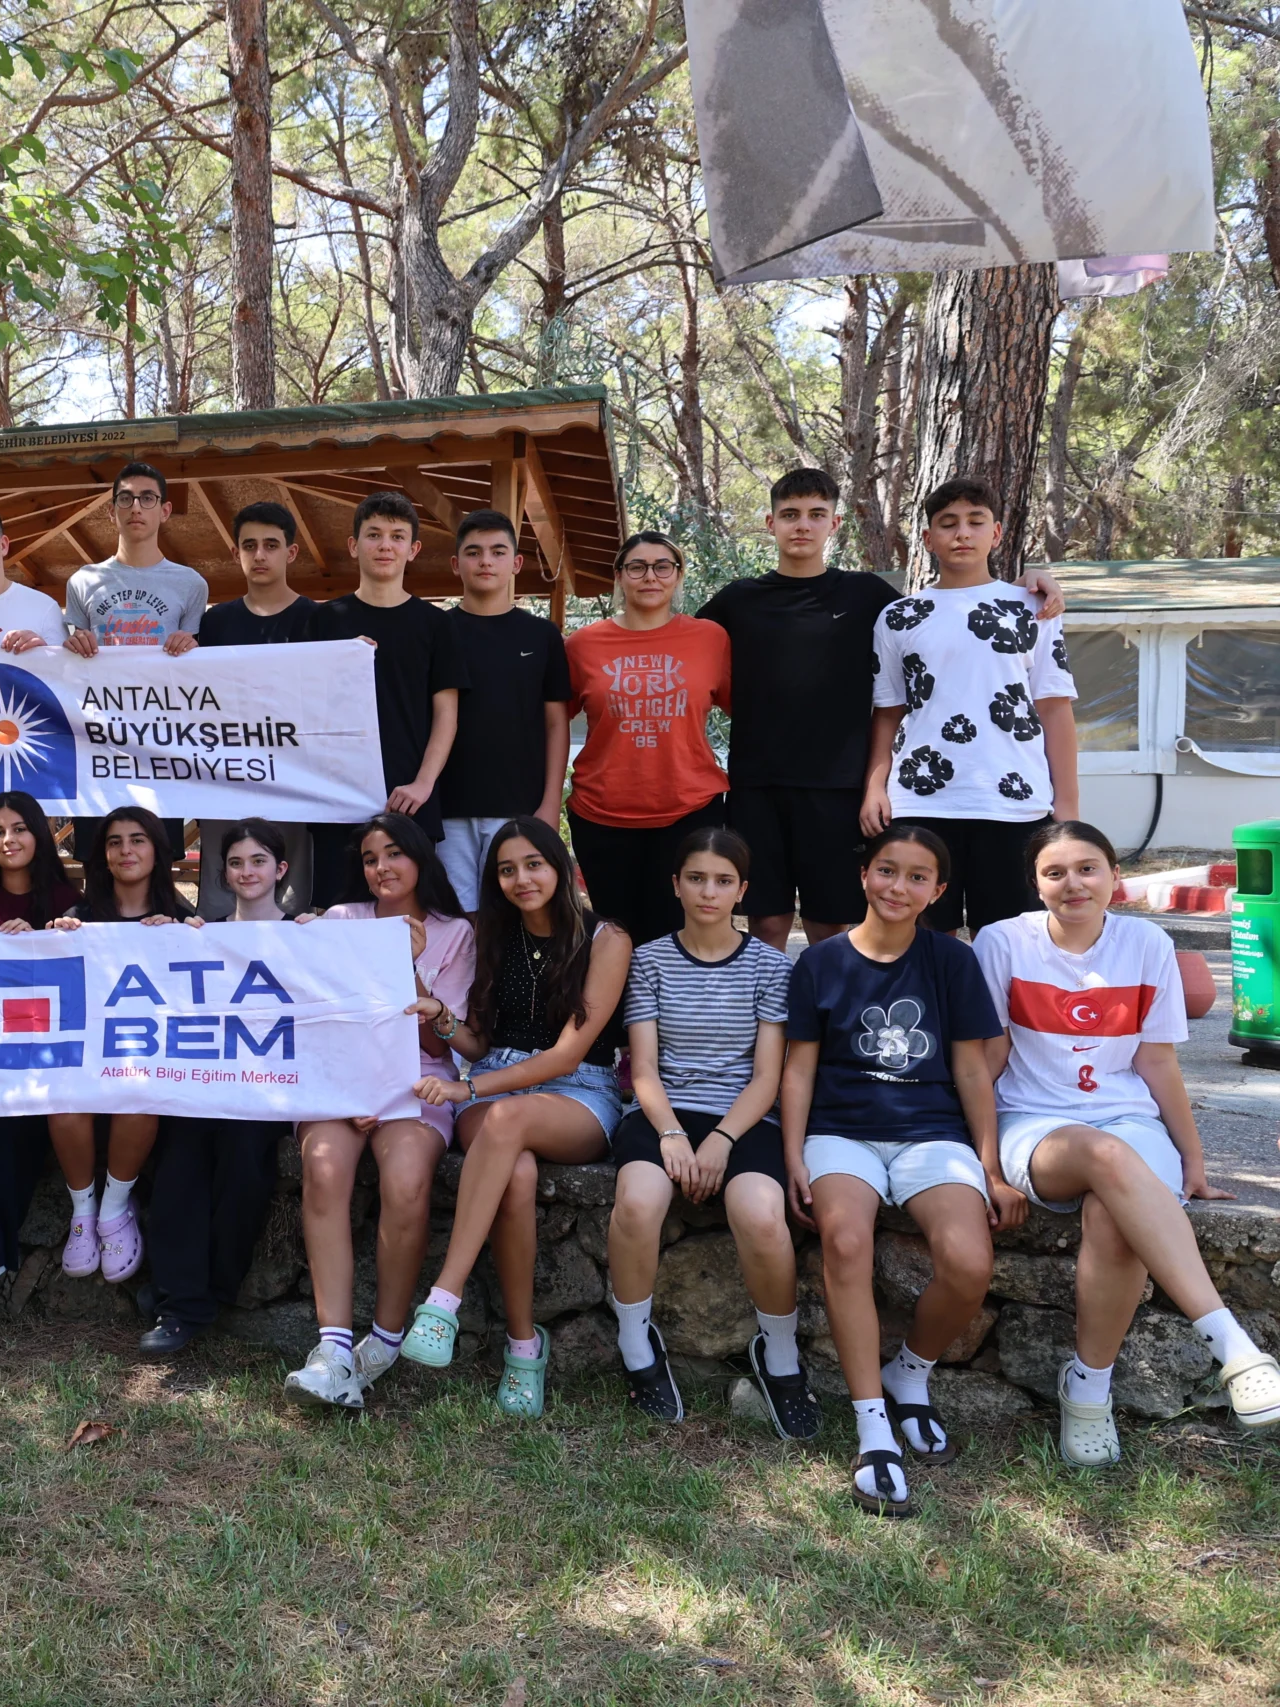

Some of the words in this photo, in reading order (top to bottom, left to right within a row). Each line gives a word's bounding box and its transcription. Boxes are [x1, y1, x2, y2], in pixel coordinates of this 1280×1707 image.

[29, 429, 98, 447] BELEDİYESİ
[102, 431, 125, 441] 2022
[96, 599, 112, 616] ONE
[111, 589, 132, 604] STEP
[135, 589, 147, 600] UP
[146, 594, 169, 616] LEVEL
[624, 654, 663, 668] NEW
[602, 654, 686, 696] YORK
[81, 686, 221, 711] ANTALYA
[606, 688, 688, 719] HILFIGER
[85, 716, 299, 752] BÜYÜKŞEHİR
[619, 720, 672, 733] CREW
[92, 753, 275, 781] BELEDİYESİ
[104, 960, 294, 1007] ATA
[102, 1015, 295, 1060] BEM
[101, 1066, 151, 1078] Atatürk
[156, 1067, 186, 1082] Bilgi
[191, 1068, 236, 1084] Eğitim
[241, 1070, 299, 1084] Merkezi
